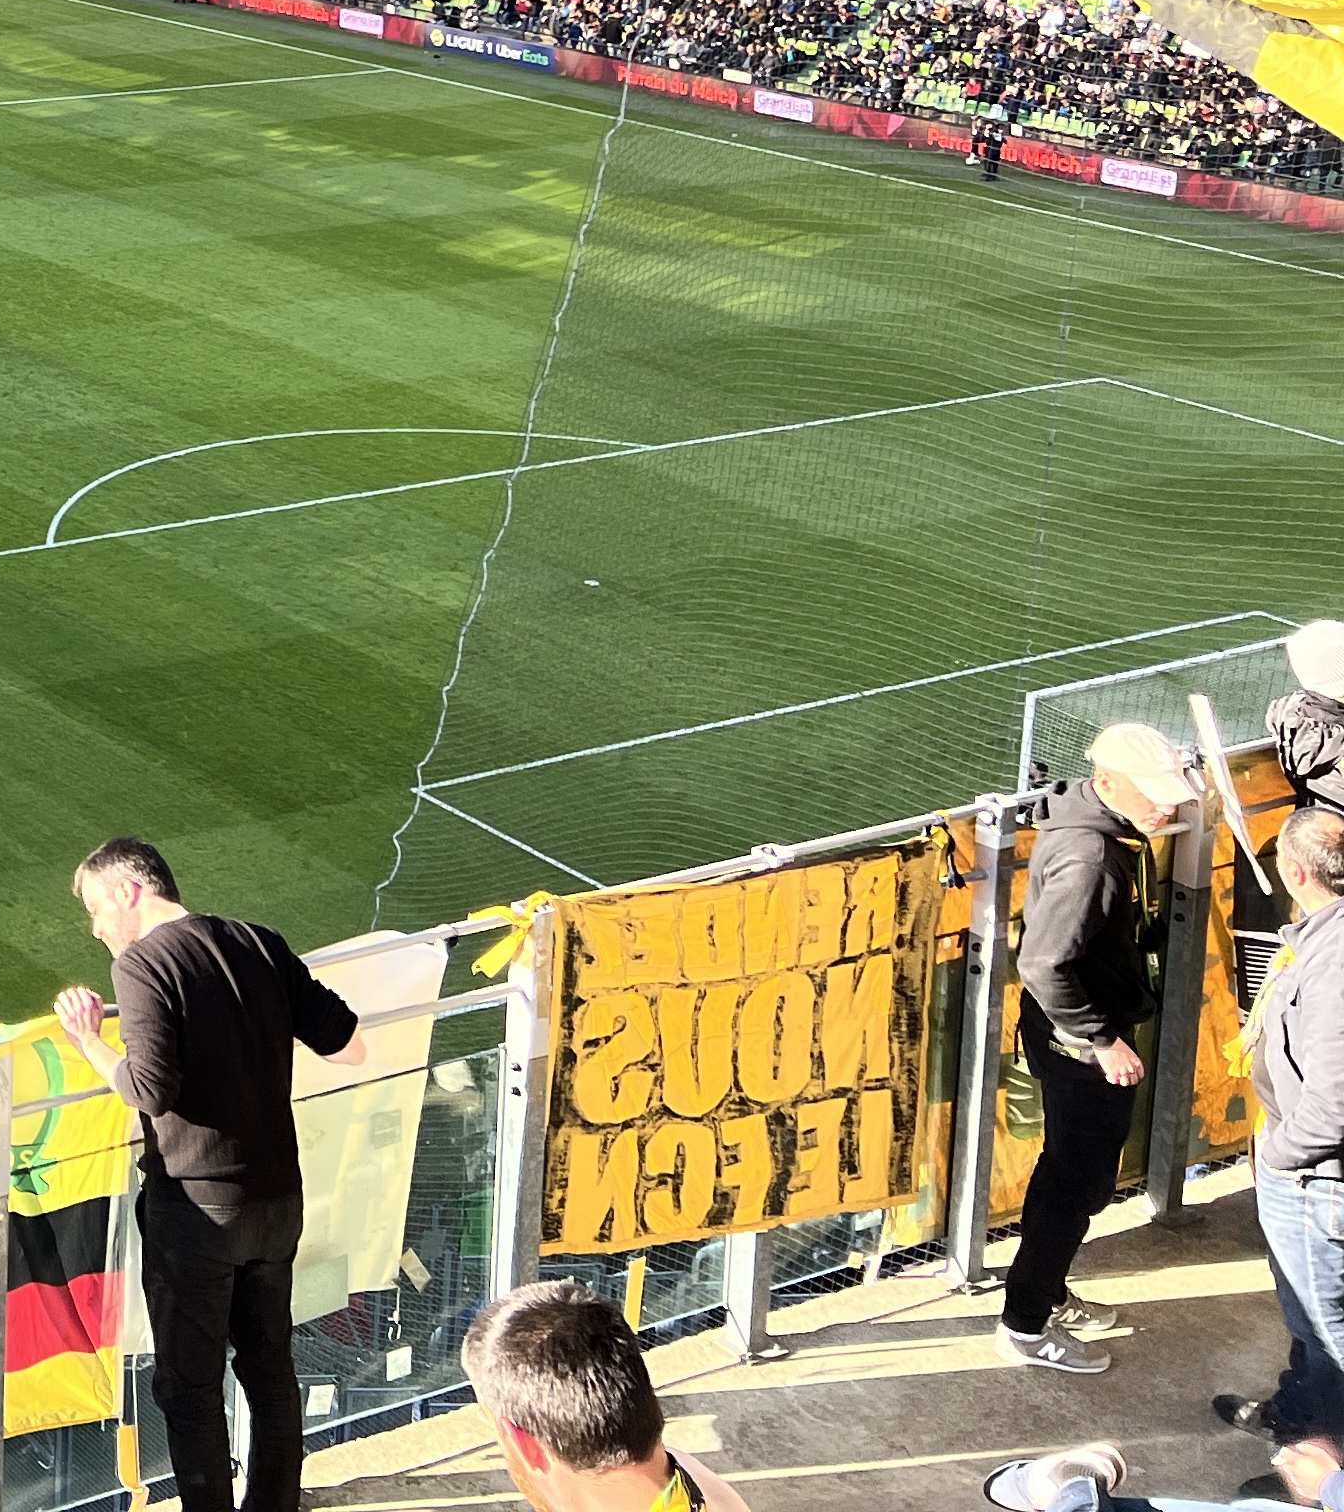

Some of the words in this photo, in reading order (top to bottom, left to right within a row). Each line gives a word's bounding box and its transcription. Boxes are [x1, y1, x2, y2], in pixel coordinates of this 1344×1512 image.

[277, 0, 293, 16] du
[294, 2, 330, 23] Match
[445, 33, 485, 54] LIGUE
[485, 41, 493, 55] 1
[495, 43, 522, 61] Uber
[522, 49, 549, 66] Eats
[669, 75, 688, 96] du
[756, 93, 792, 111] Grand
[1022, 145, 1083, 175] Match
[1106, 162, 1149, 181] Grand
[1150, 169, 1172, 186] Est
